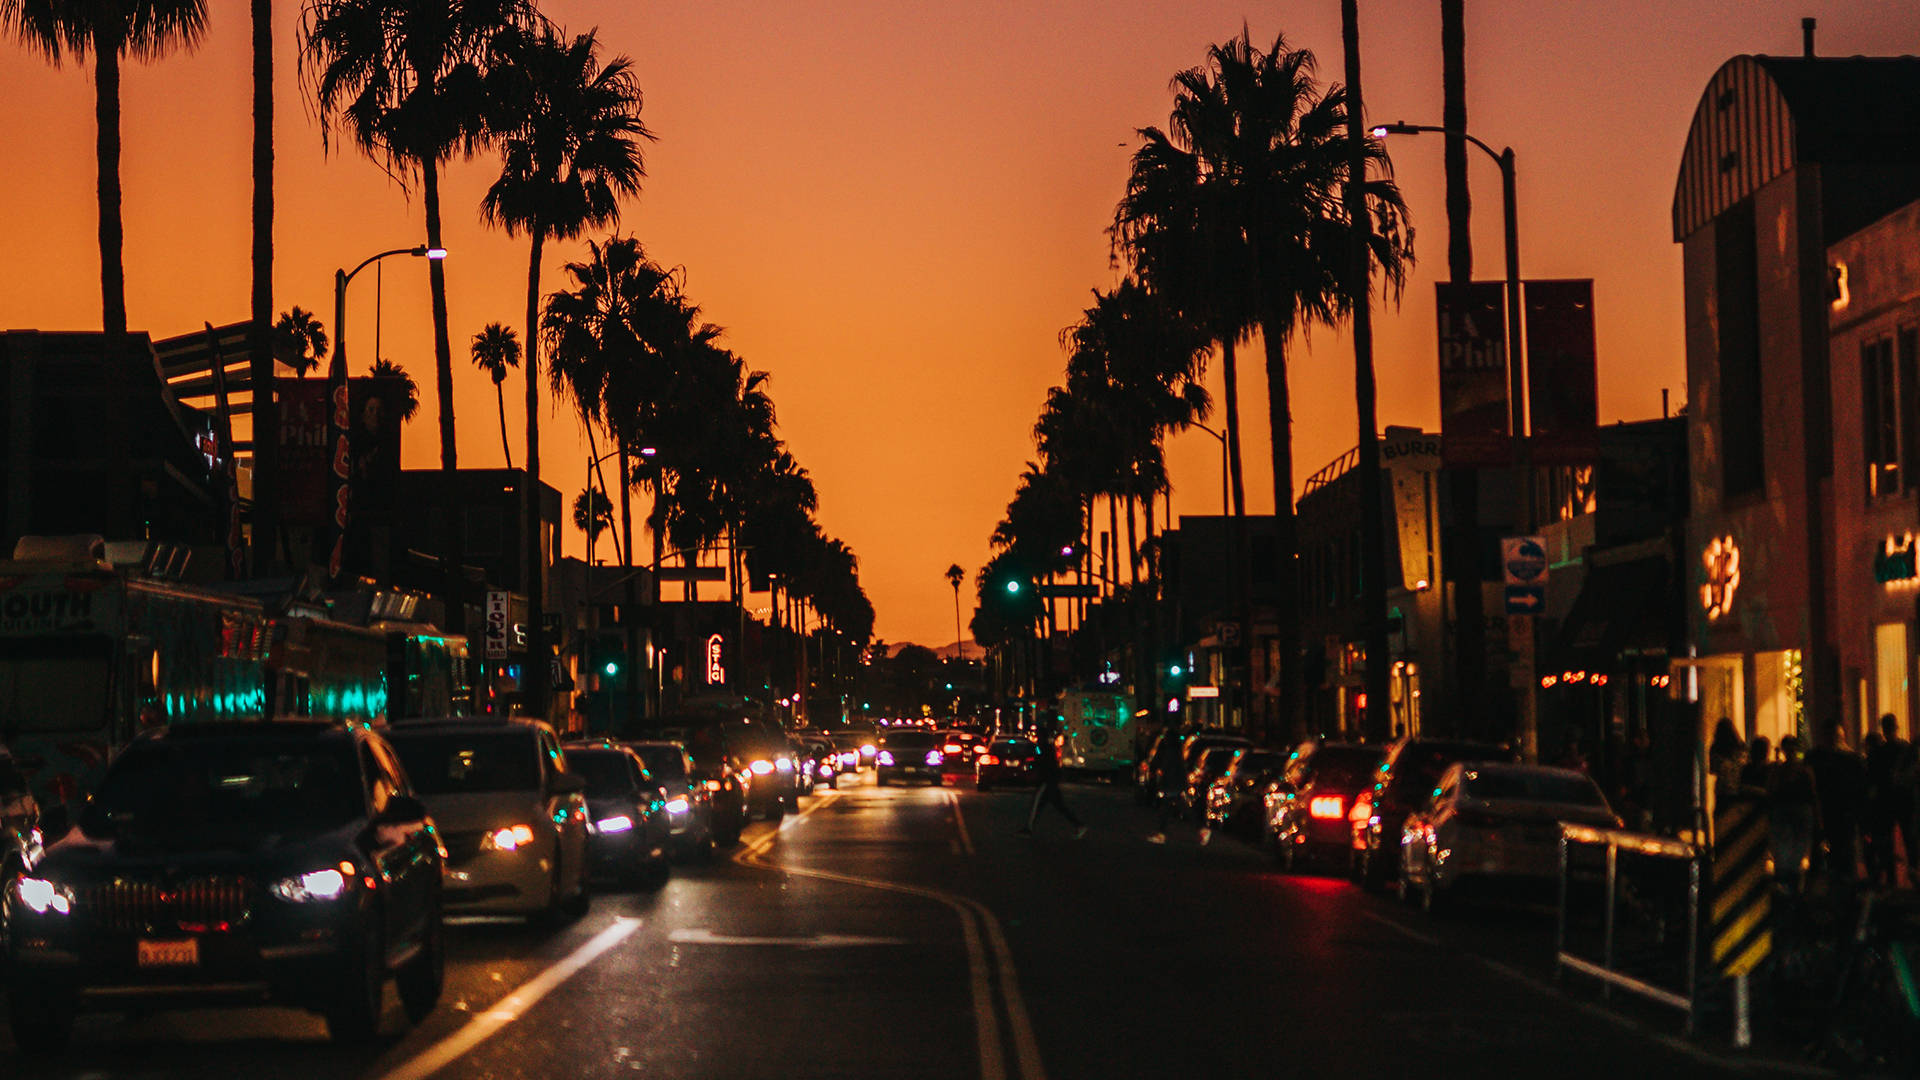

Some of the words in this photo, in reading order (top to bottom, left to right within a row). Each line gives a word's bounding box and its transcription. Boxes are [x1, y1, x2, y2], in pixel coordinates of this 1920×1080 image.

[1441, 311, 1479, 338] LA
[1442, 339, 1503, 369] Phil
[279, 423, 329, 447] Phil
[1383, 440, 1439, 460] BURR
